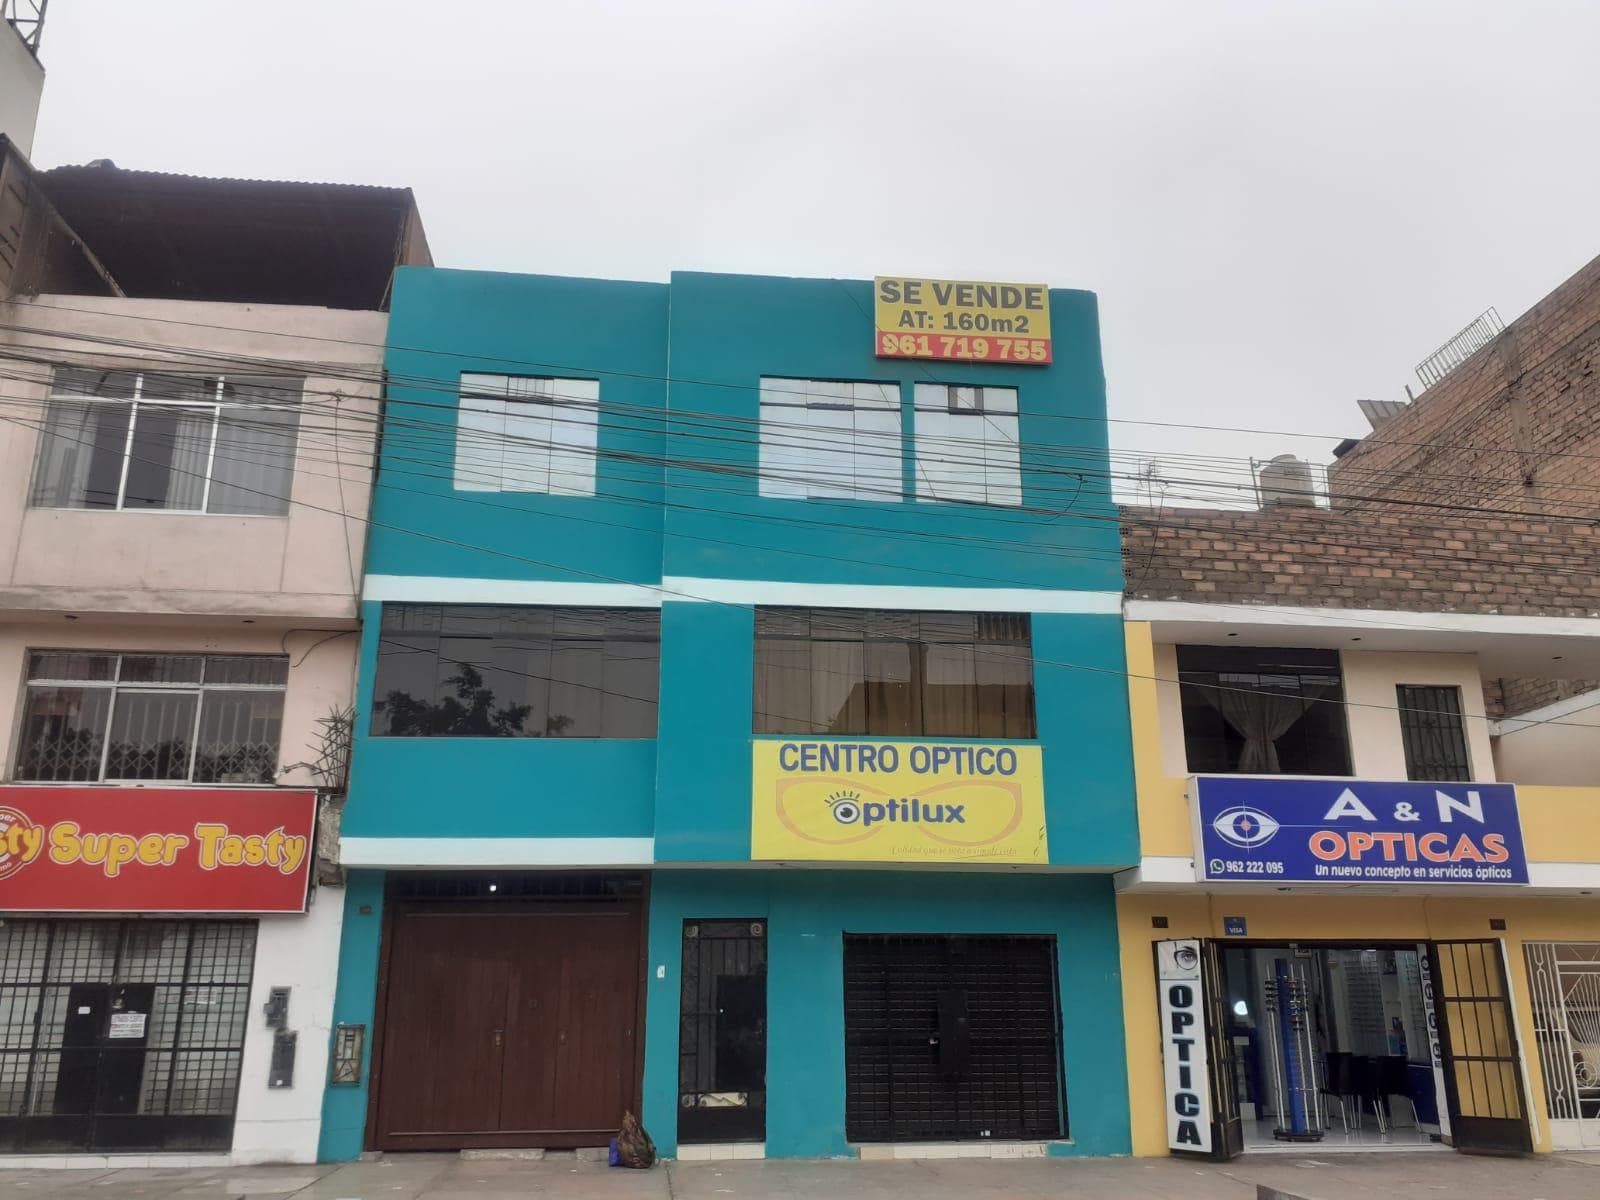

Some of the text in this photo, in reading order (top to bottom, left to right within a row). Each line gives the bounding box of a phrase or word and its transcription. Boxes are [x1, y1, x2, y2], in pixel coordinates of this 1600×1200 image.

[880, 280, 1043, 310] SE VENDE
[899, 310, 1029, 333] AT: 160m2
[881, 333, 1047, 360] 961 719 755
[779, 743, 1017, 775] CENTRO OPTICO
[1323, 787, 1485, 824] A & N
[49, 821, 307, 878] Super Tasty
[1308, 830, 1509, 863] OPTICAS
[1226, 861, 1284, 874] 962 222 095
[1315, 864, 1512, 880] Un nuevo concepto en servicios ópticos
[1168, 984, 1203, 1146] OPTICA
